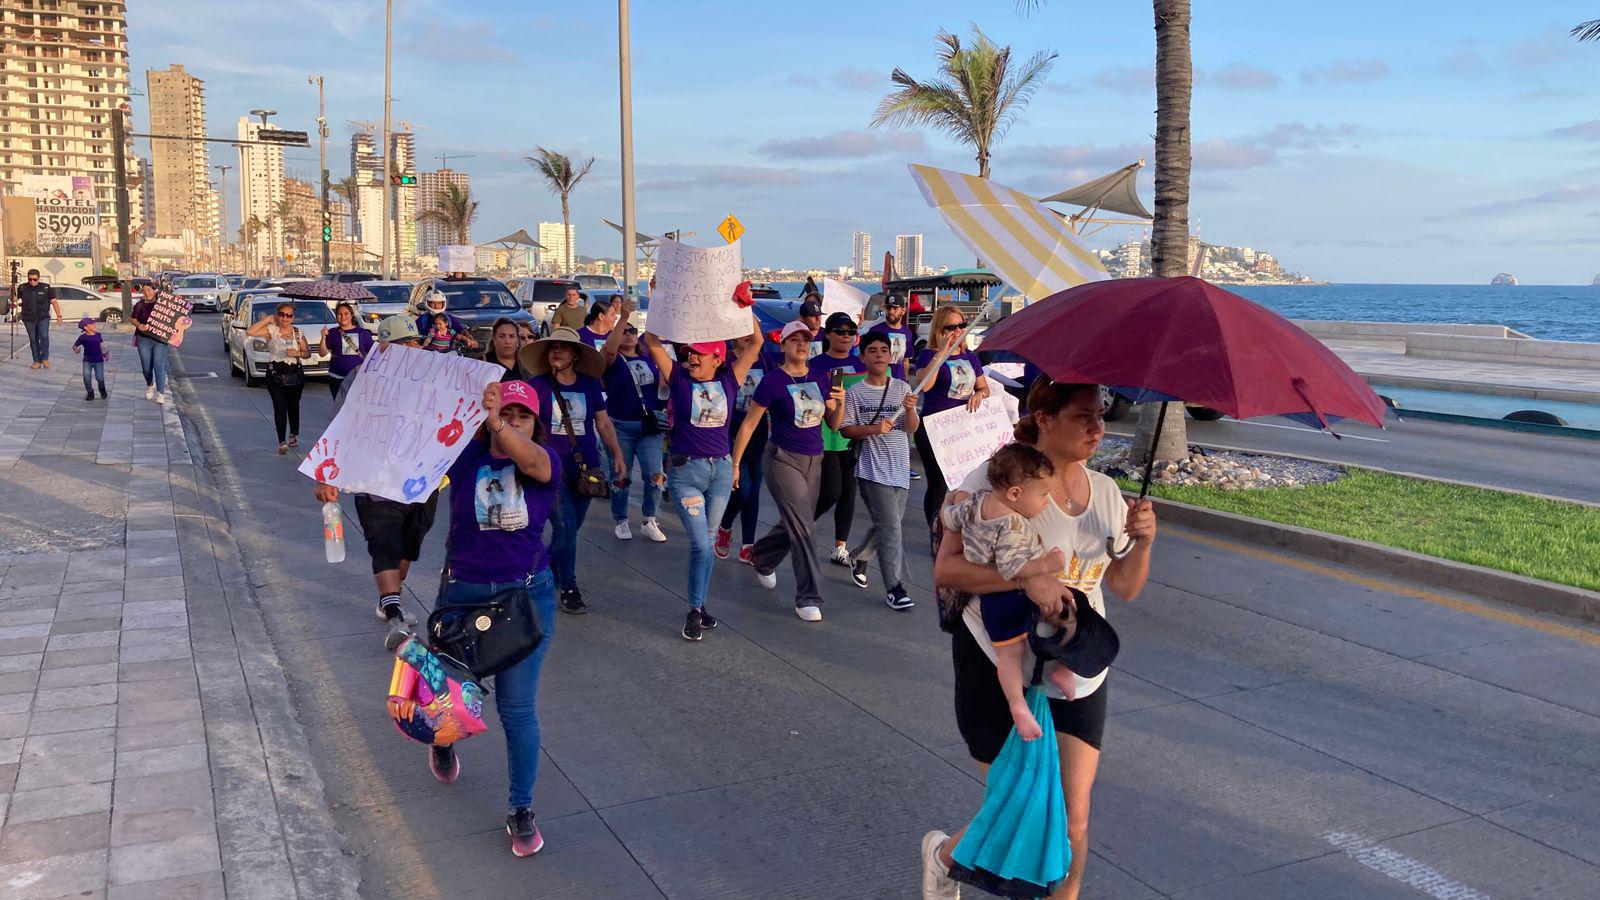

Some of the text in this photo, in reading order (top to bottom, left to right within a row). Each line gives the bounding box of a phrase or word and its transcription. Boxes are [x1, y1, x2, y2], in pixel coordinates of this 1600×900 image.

[36, 198, 95, 207] HOTEL
[36, 206, 96, 215] HABITACION
[157, 298, 167, 306] LA
[168, 302, 182, 312] VOZ
[161, 291, 187, 306] HOY SOY
[151, 311, 171, 322] GRITO
[154, 304, 175, 317] QUIEN
[147, 317, 177, 334] PIDIENDO
[394, 346, 436, 382] NO
